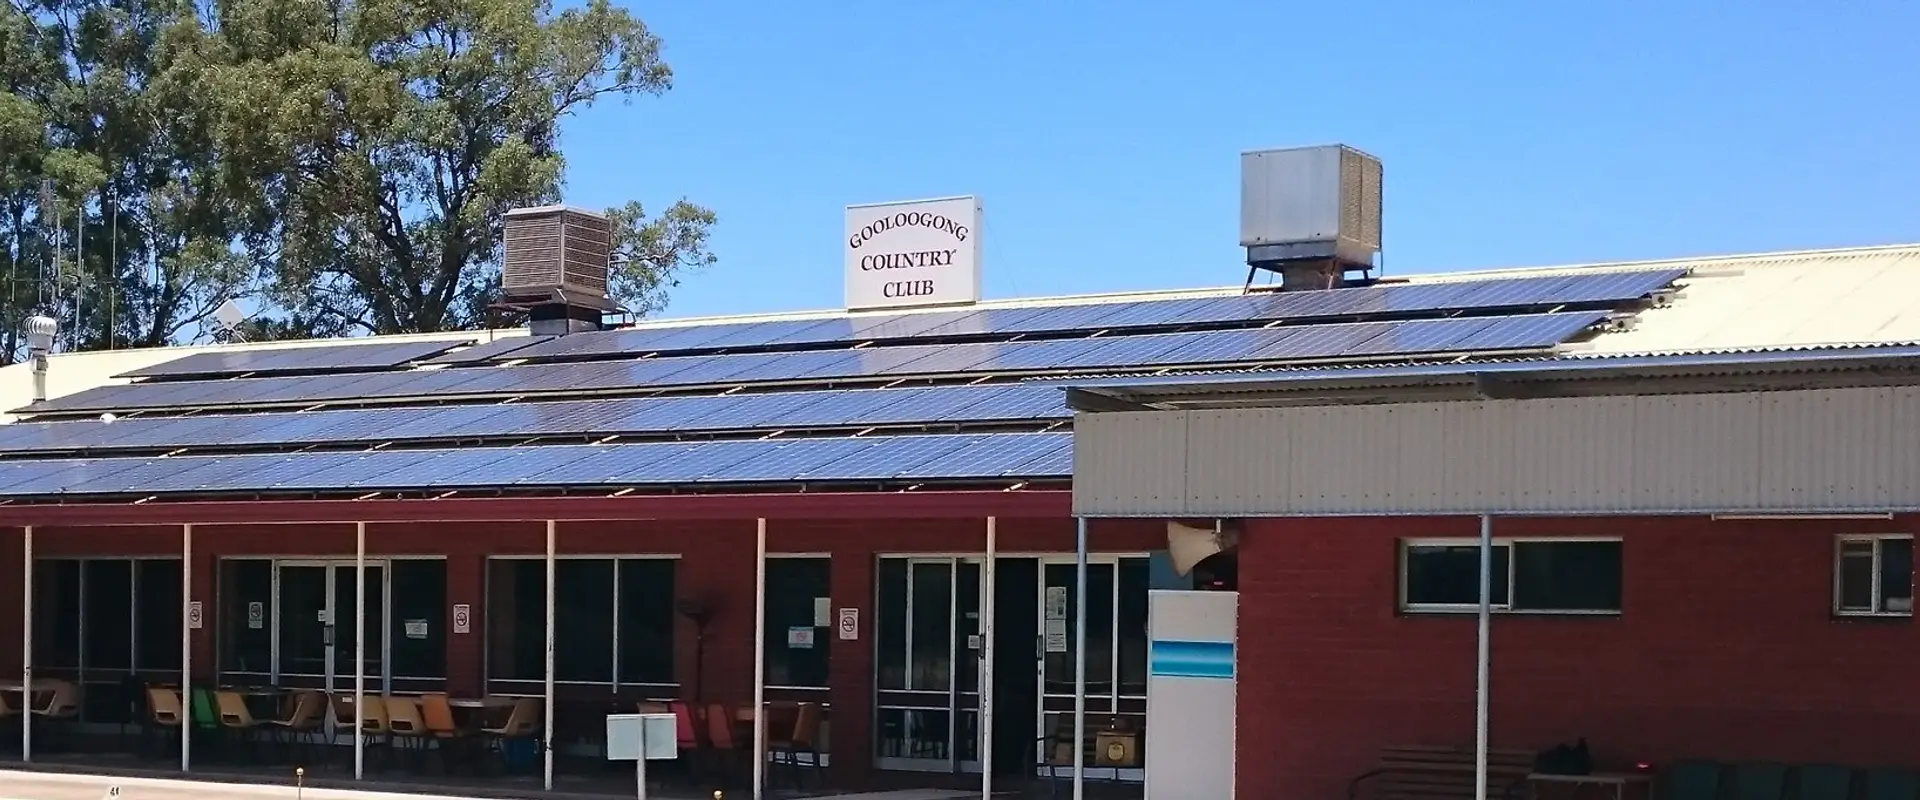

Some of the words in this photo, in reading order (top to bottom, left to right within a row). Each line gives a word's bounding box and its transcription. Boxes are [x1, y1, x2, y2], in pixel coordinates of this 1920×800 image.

[850, 212, 969, 249] GOOLOOGONG
[861, 249, 957, 271] COUNTRY
[883, 279, 934, 298] CLUB
